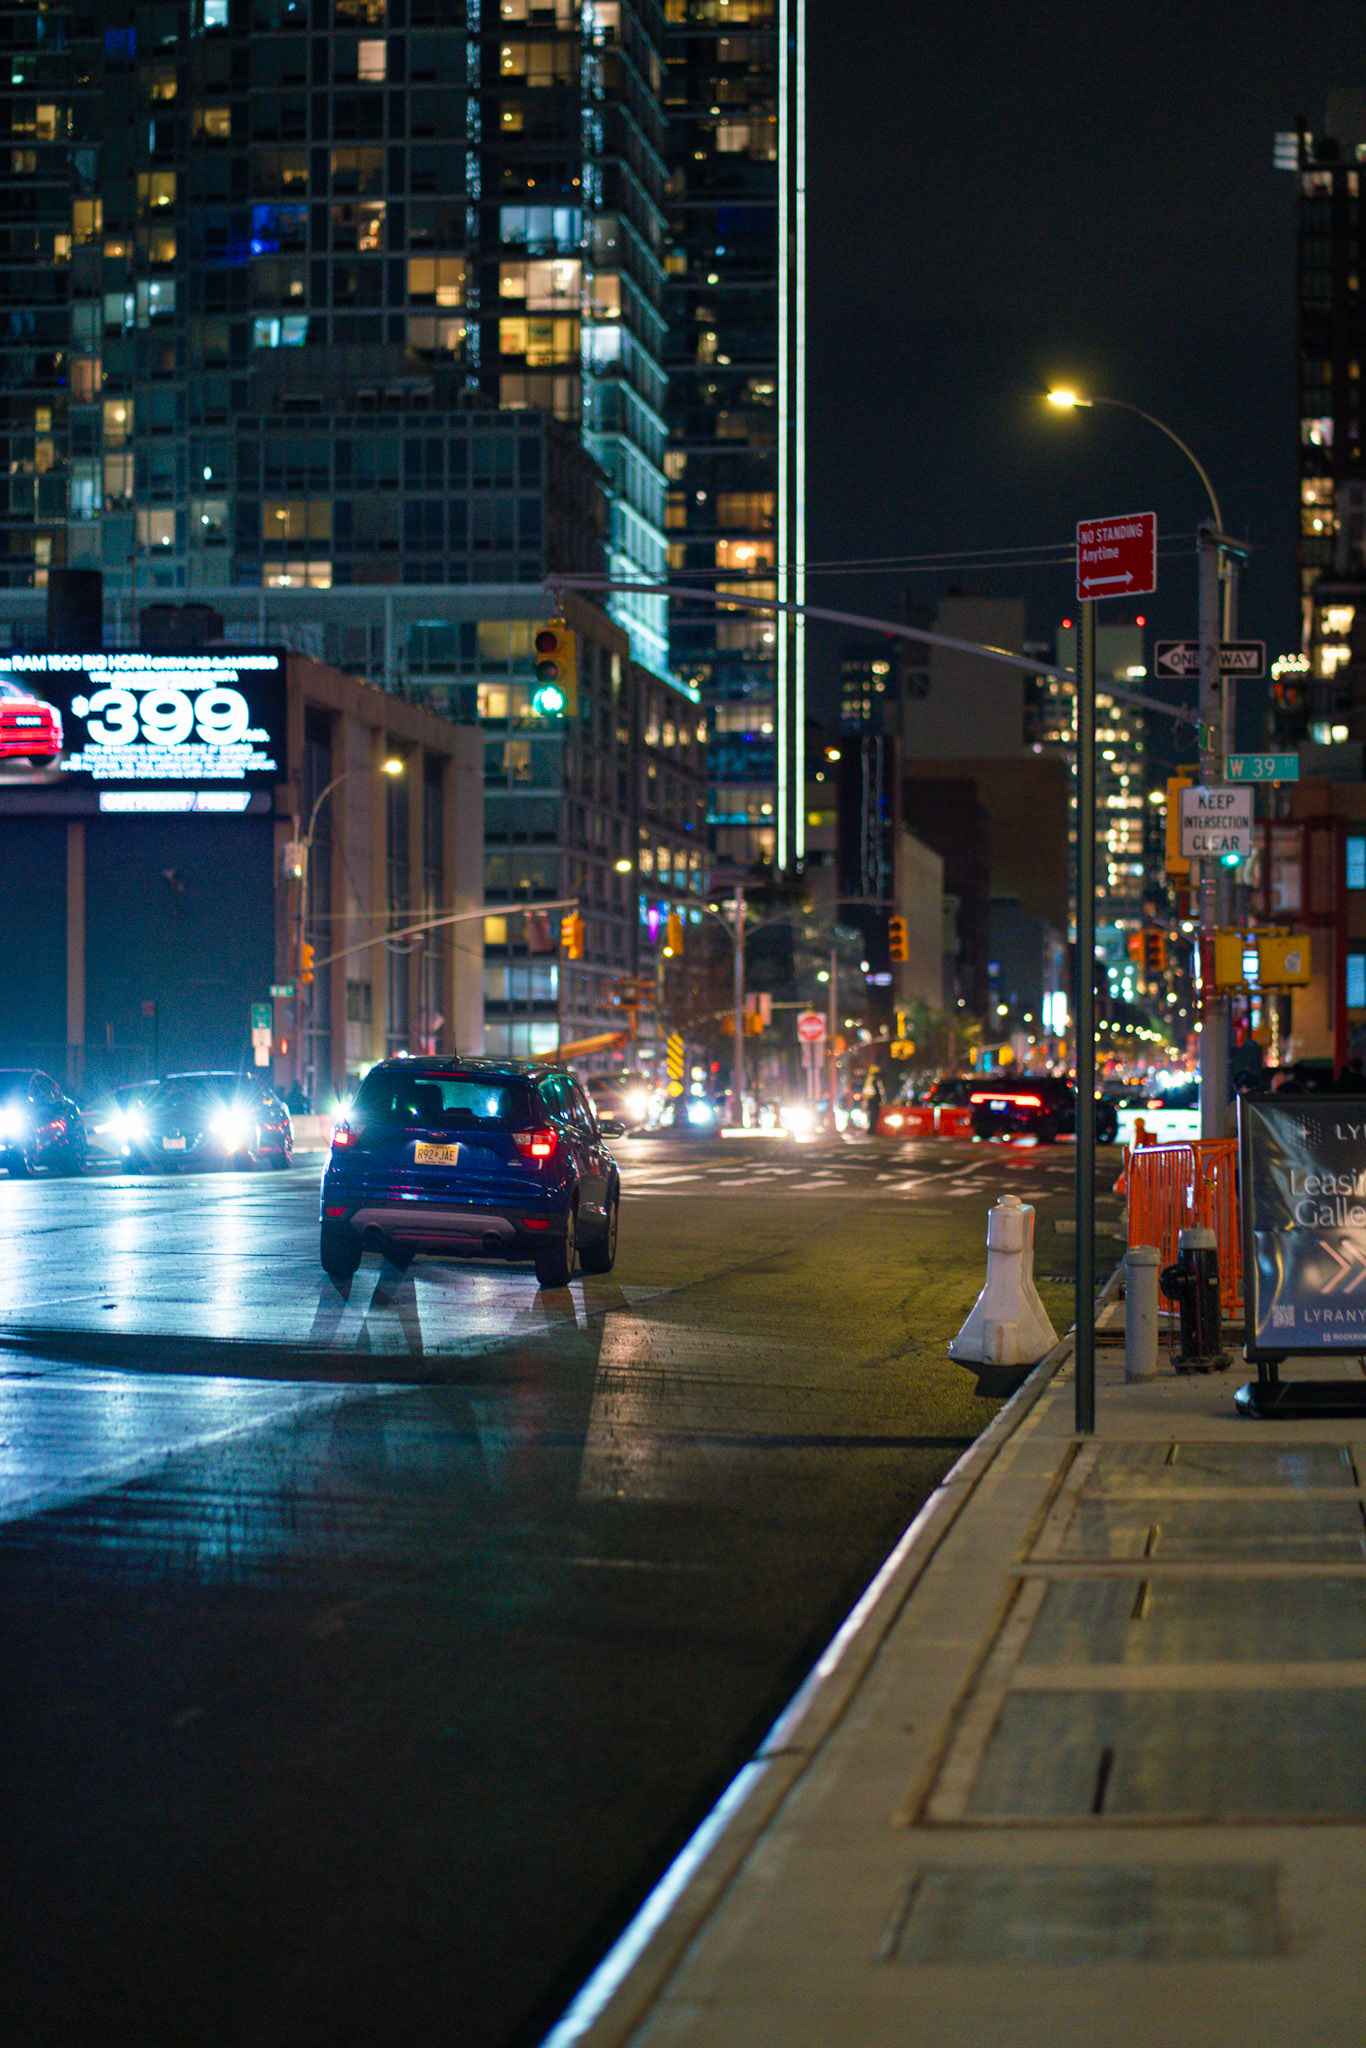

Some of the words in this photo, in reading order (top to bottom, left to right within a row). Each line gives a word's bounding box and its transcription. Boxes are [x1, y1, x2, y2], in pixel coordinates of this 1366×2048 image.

[1081, 530, 1094, 544] NO
[1096, 523, 1143, 542] STANDING
[1081, 546, 1119, 564] Anytime
[1220, 653, 1253, 666] WAY
[1230, 759, 1244, 777] W
[1253, 758, 1275, 777] 39
[1284, 759, 1294, 768] ST
[1198, 795, 1235, 809] KEEP
[1184, 816, 1248, 829] INTERSECTION
[1193, 836, 1240, 850] CLEAR
[1336, 1123, 1366, 1140] LY
